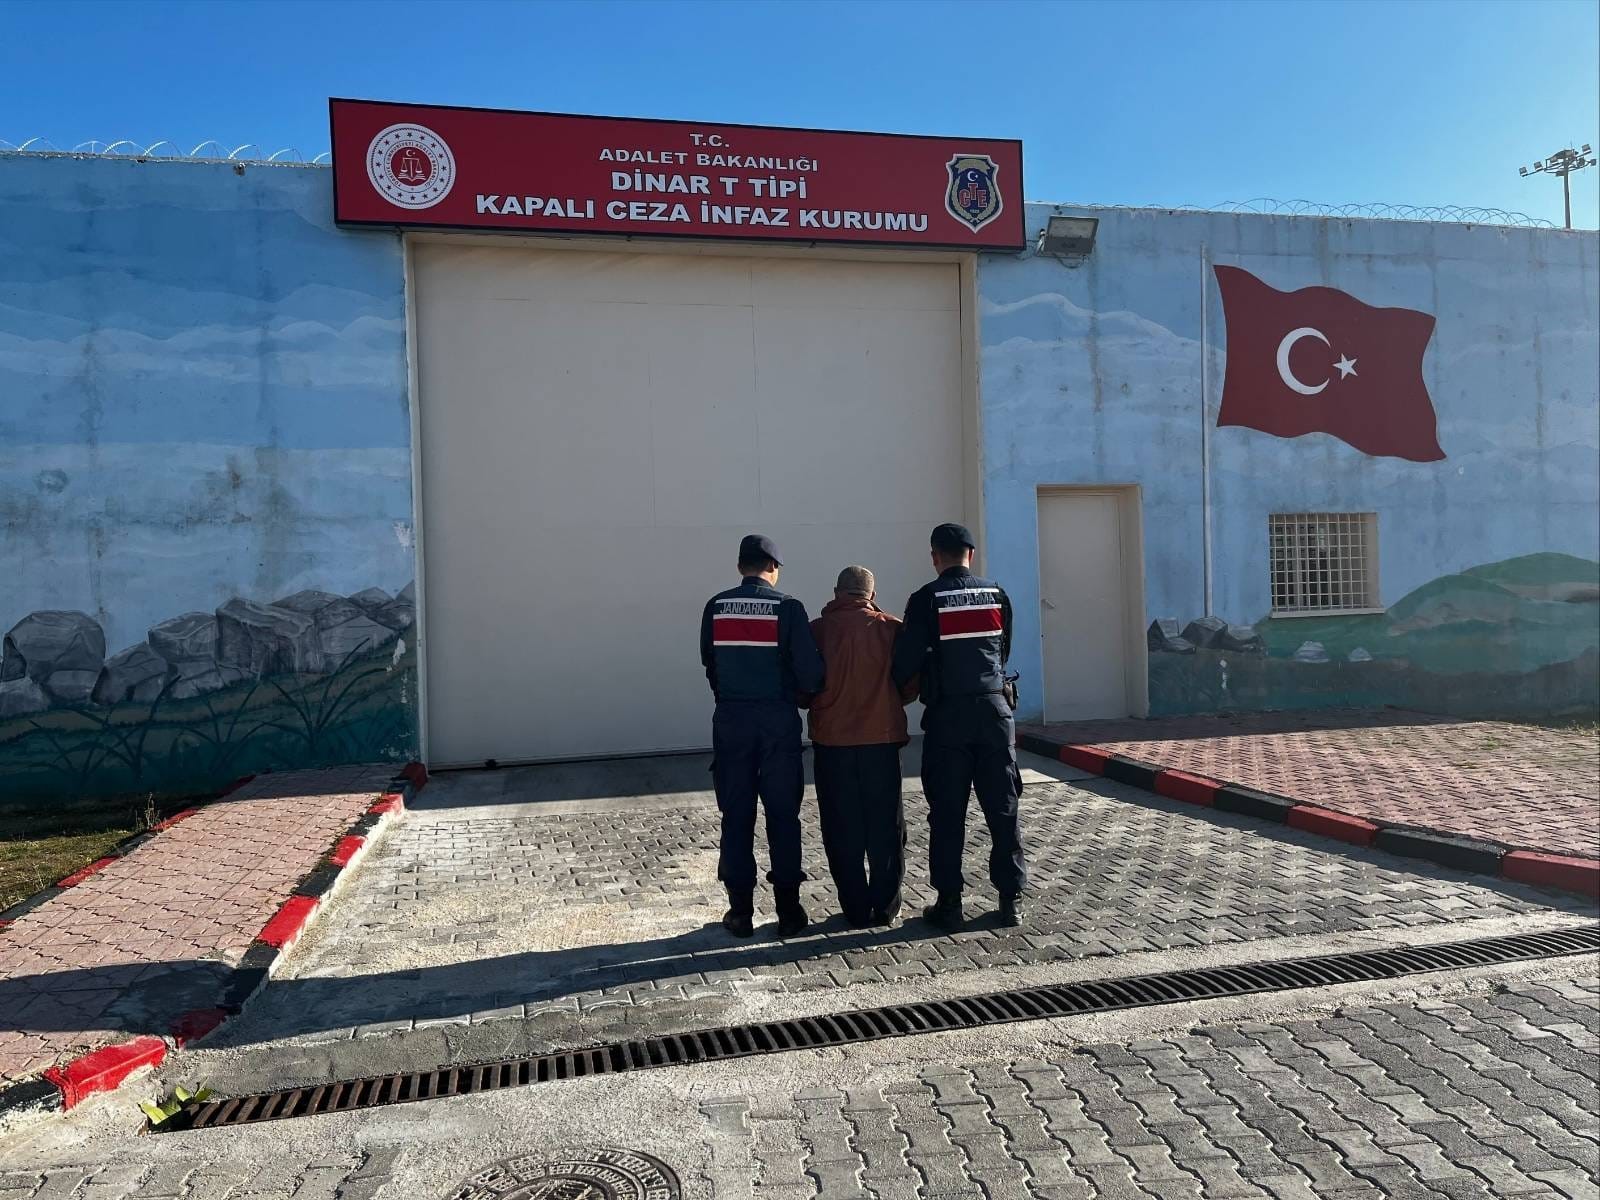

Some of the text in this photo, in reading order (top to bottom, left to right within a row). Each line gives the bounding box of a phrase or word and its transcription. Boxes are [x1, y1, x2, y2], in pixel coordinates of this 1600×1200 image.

[690, 133, 730, 148] T.C.
[599, 148, 819, 172] ADALET BAKANLIĞI
[611, 168, 808, 199] DİNAR T TİPİ
[475, 194, 929, 232] KAPALI CEZA İNFAZ KURUMU
[719, 602, 774, 615] JANDARMA
[945, 592, 996, 608] JANDARMA
